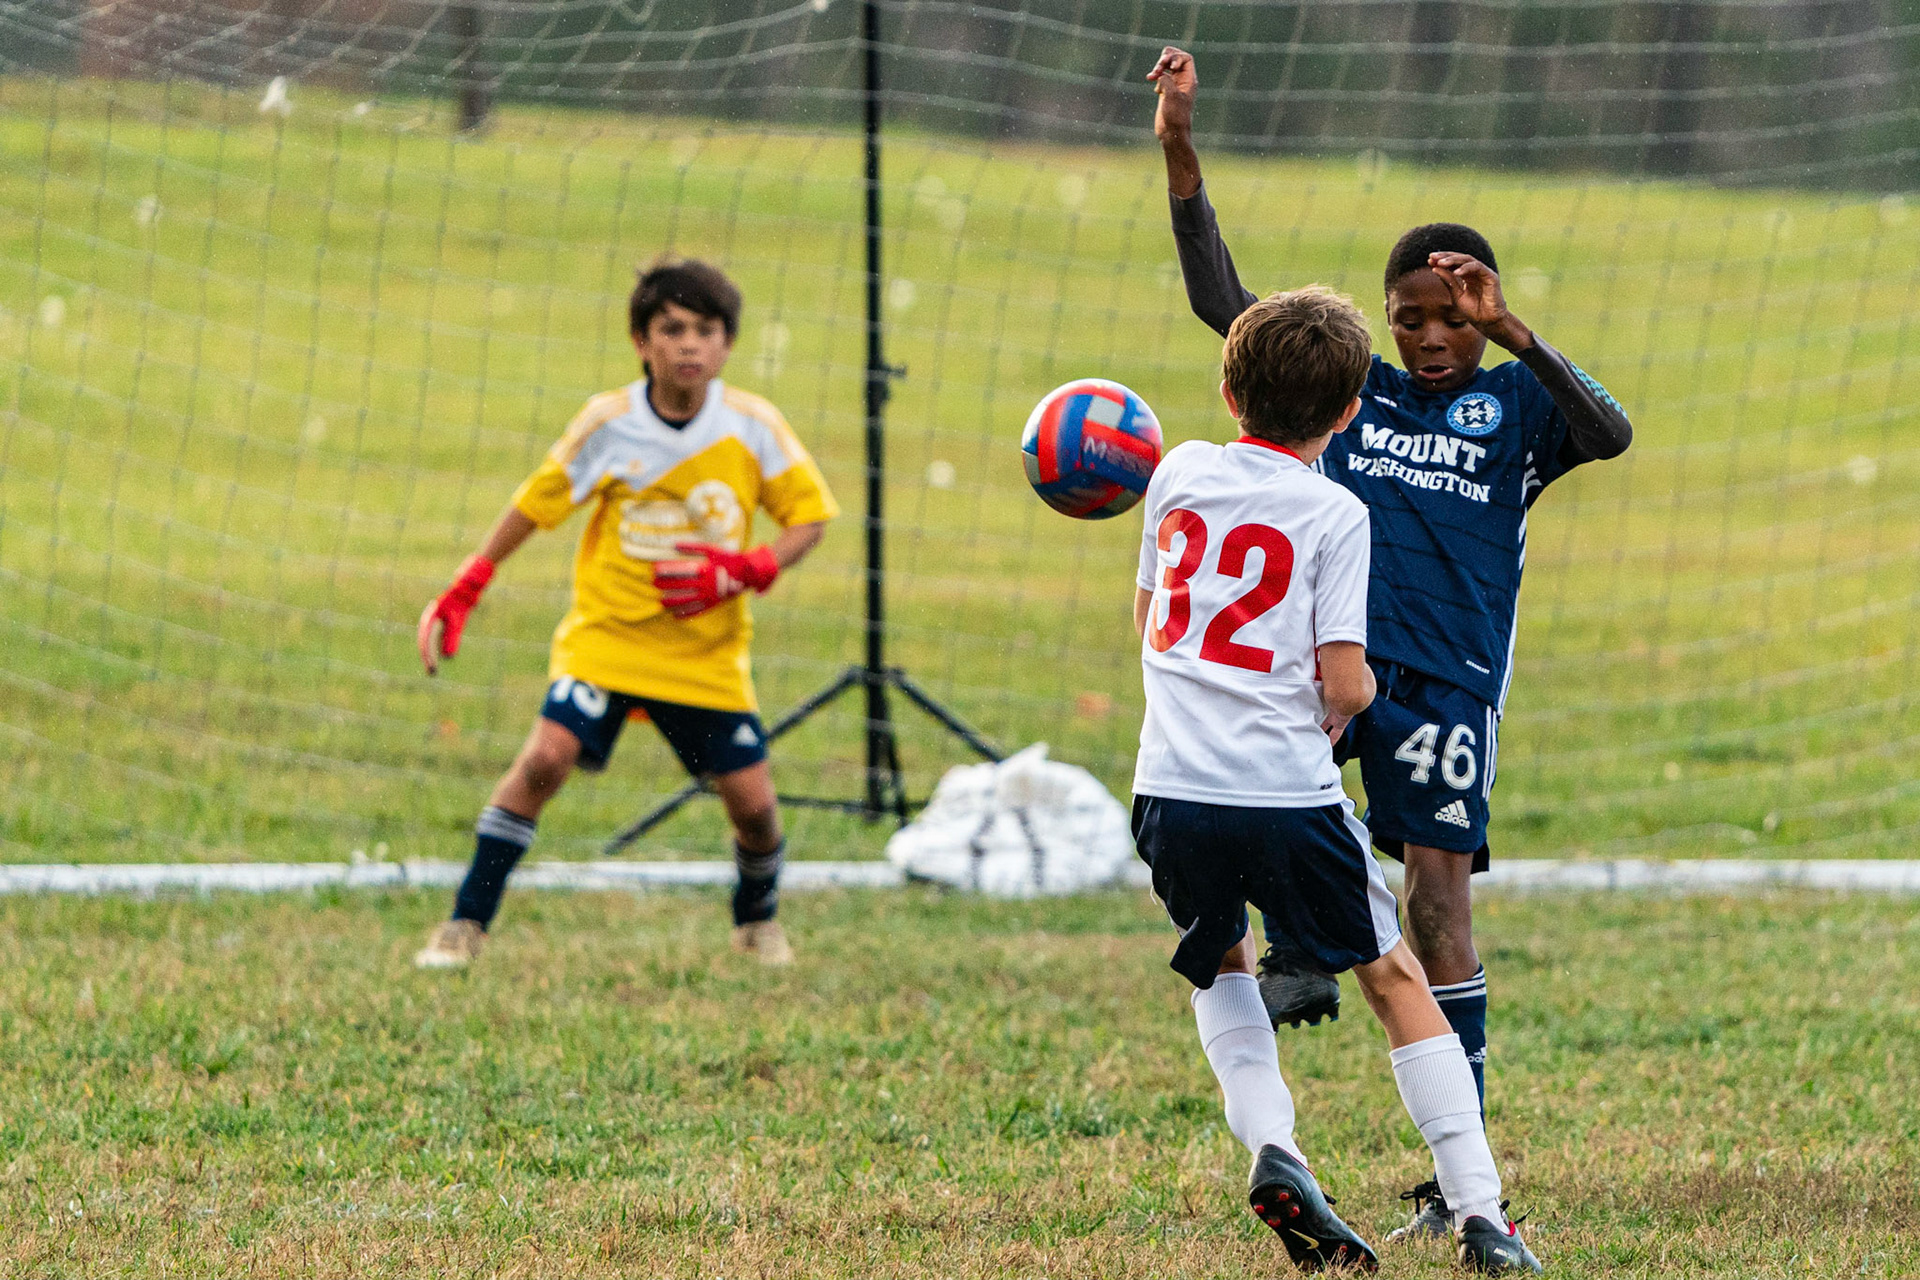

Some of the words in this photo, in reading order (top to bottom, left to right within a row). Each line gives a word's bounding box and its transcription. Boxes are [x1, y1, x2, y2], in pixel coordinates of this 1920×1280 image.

[1361, 423, 1487, 473] MOUNT
[1348, 453, 1491, 503] WASHINGTON
[1149, 507, 1295, 674] 32
[1394, 723, 1477, 791] 46
[1434, 811, 1471, 829] adidas
